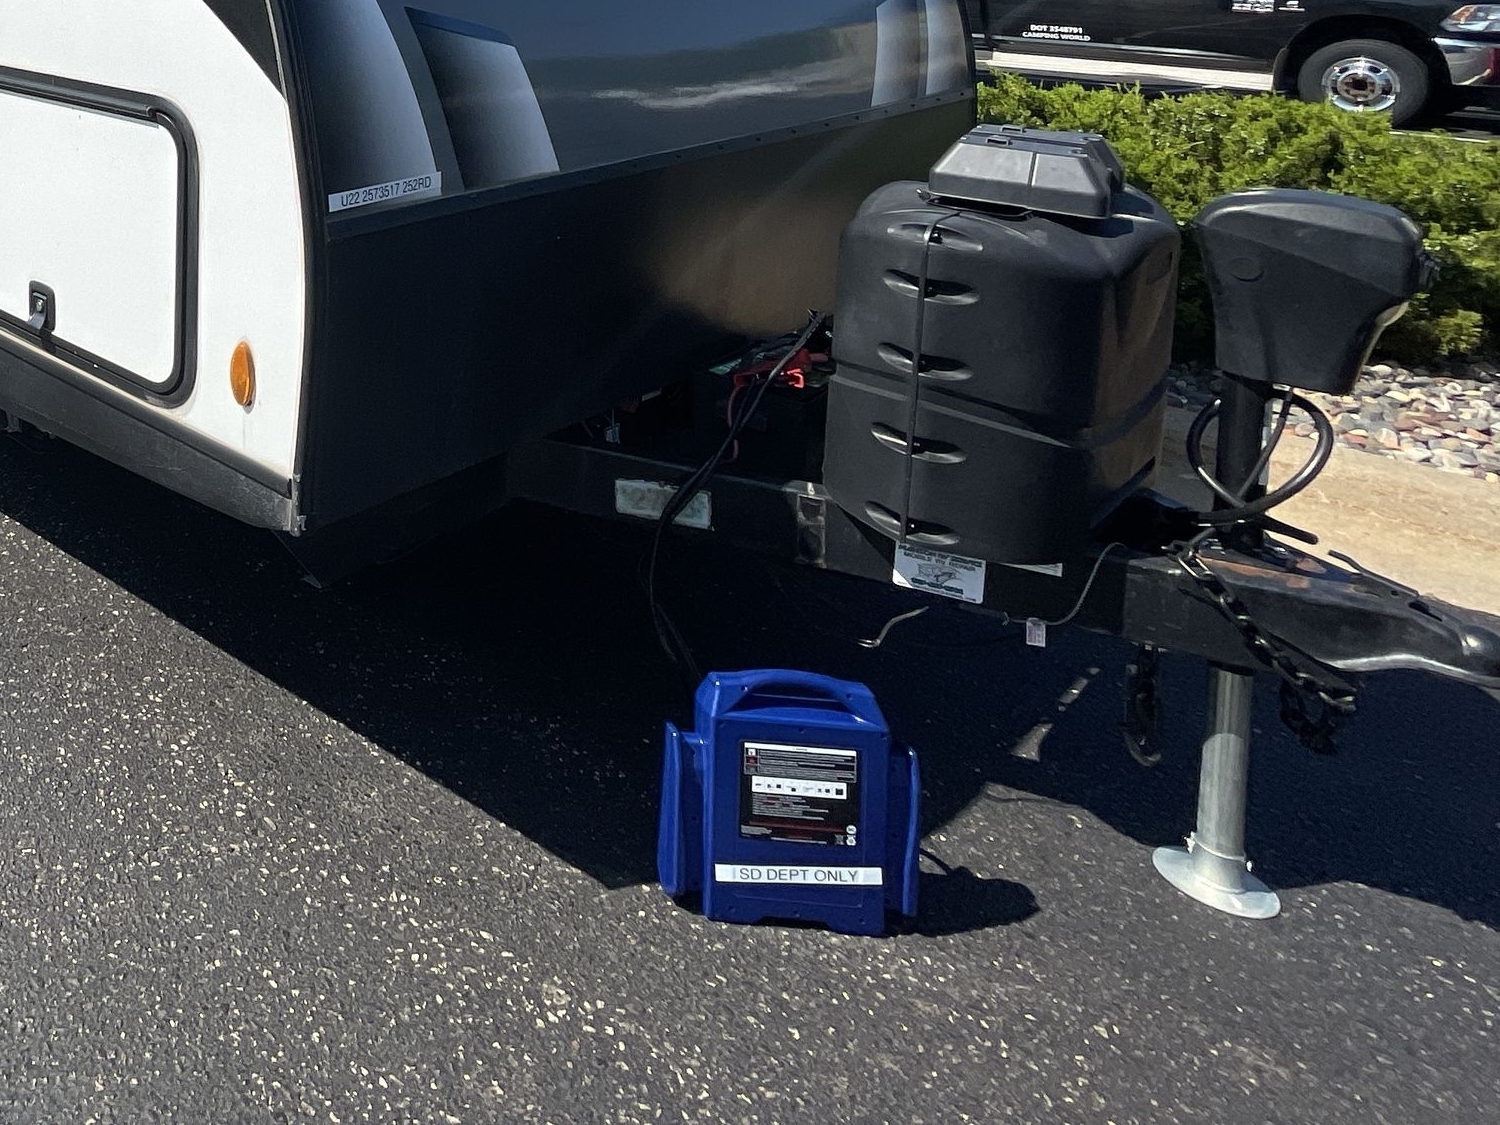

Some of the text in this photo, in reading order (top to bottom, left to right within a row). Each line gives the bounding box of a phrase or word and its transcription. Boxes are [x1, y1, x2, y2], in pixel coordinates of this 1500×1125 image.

[1022, 31, 1091, 42] CAMPING WORLD
[362, 182, 401, 203] 2573517
[402, 175, 432, 194] 252RD
[739, 867, 859, 883] SD DEPT ONLY
